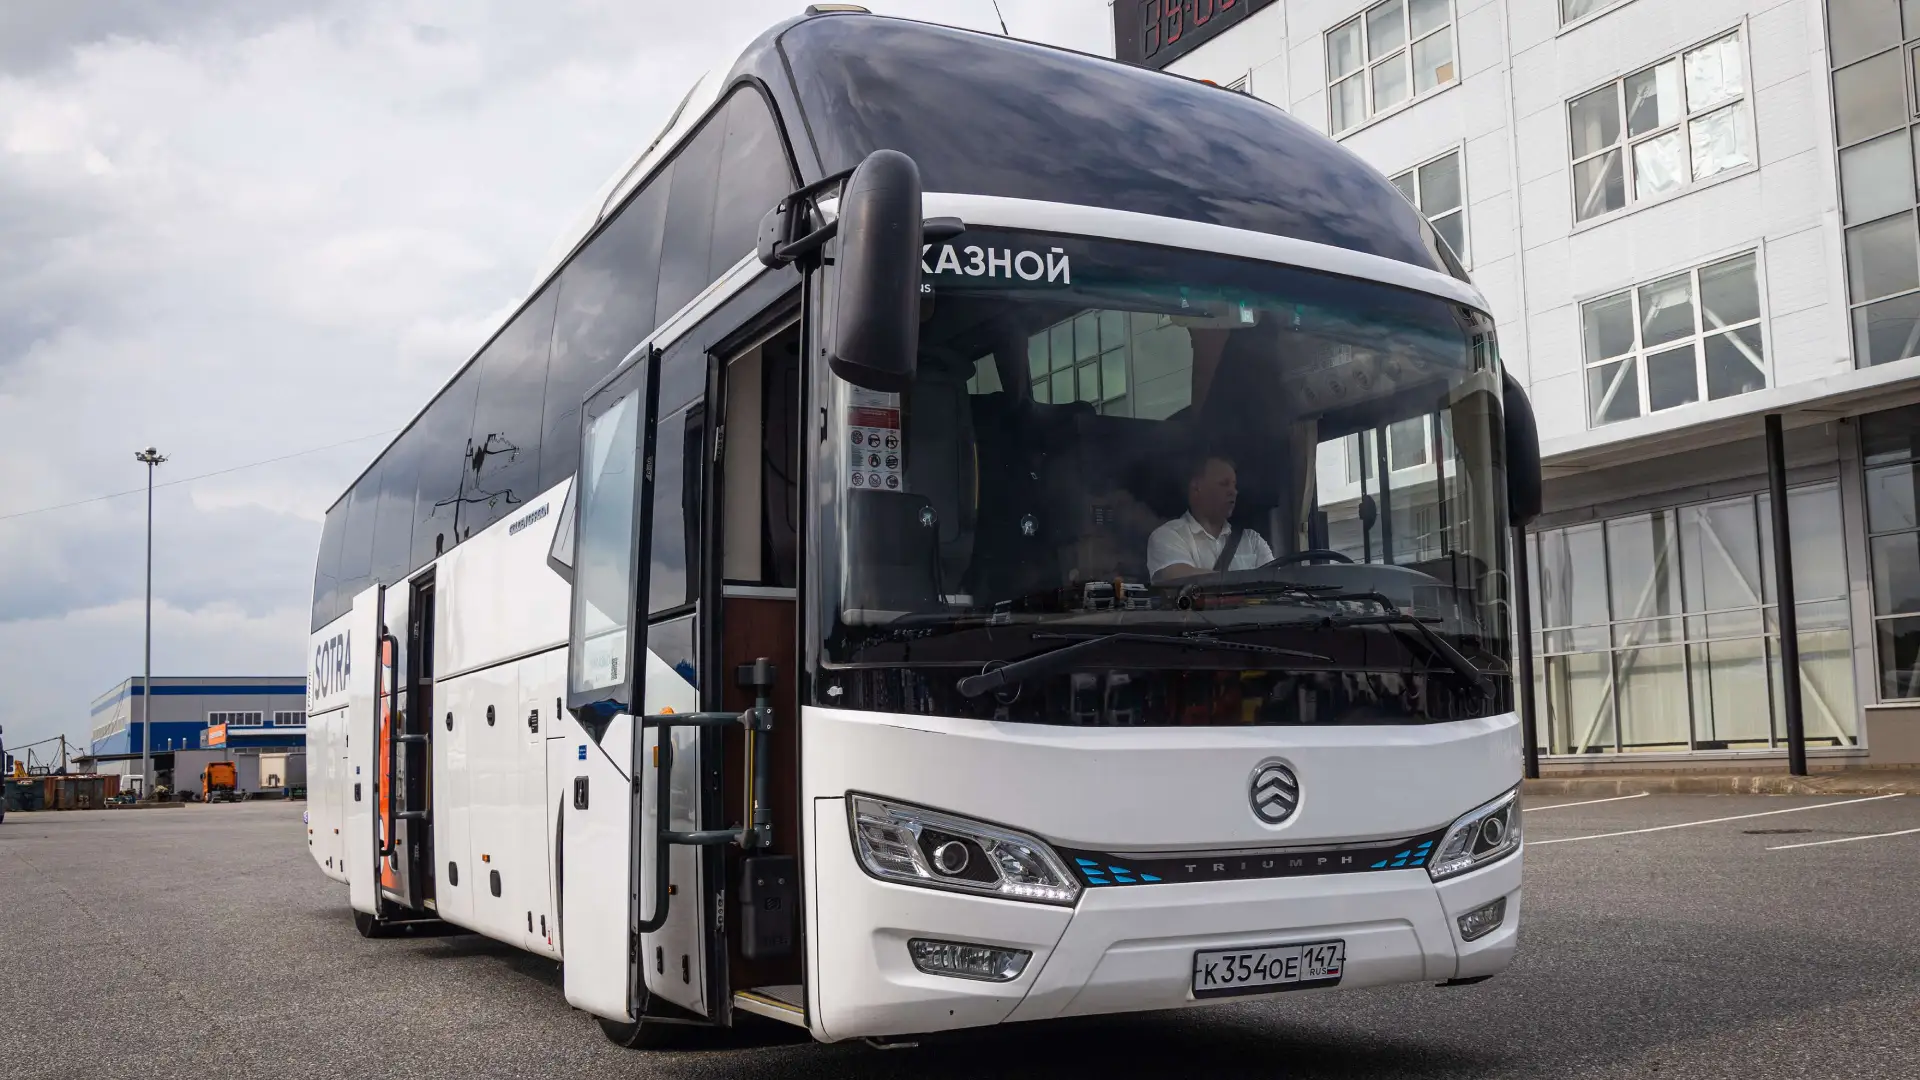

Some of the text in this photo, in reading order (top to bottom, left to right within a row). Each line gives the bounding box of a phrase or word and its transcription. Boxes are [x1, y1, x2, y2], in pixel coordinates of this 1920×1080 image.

[1185, 856, 1353, 873] TRIUMPH
[1304, 946, 1337, 968] 147
[1309, 967, 1327, 977] RUS
